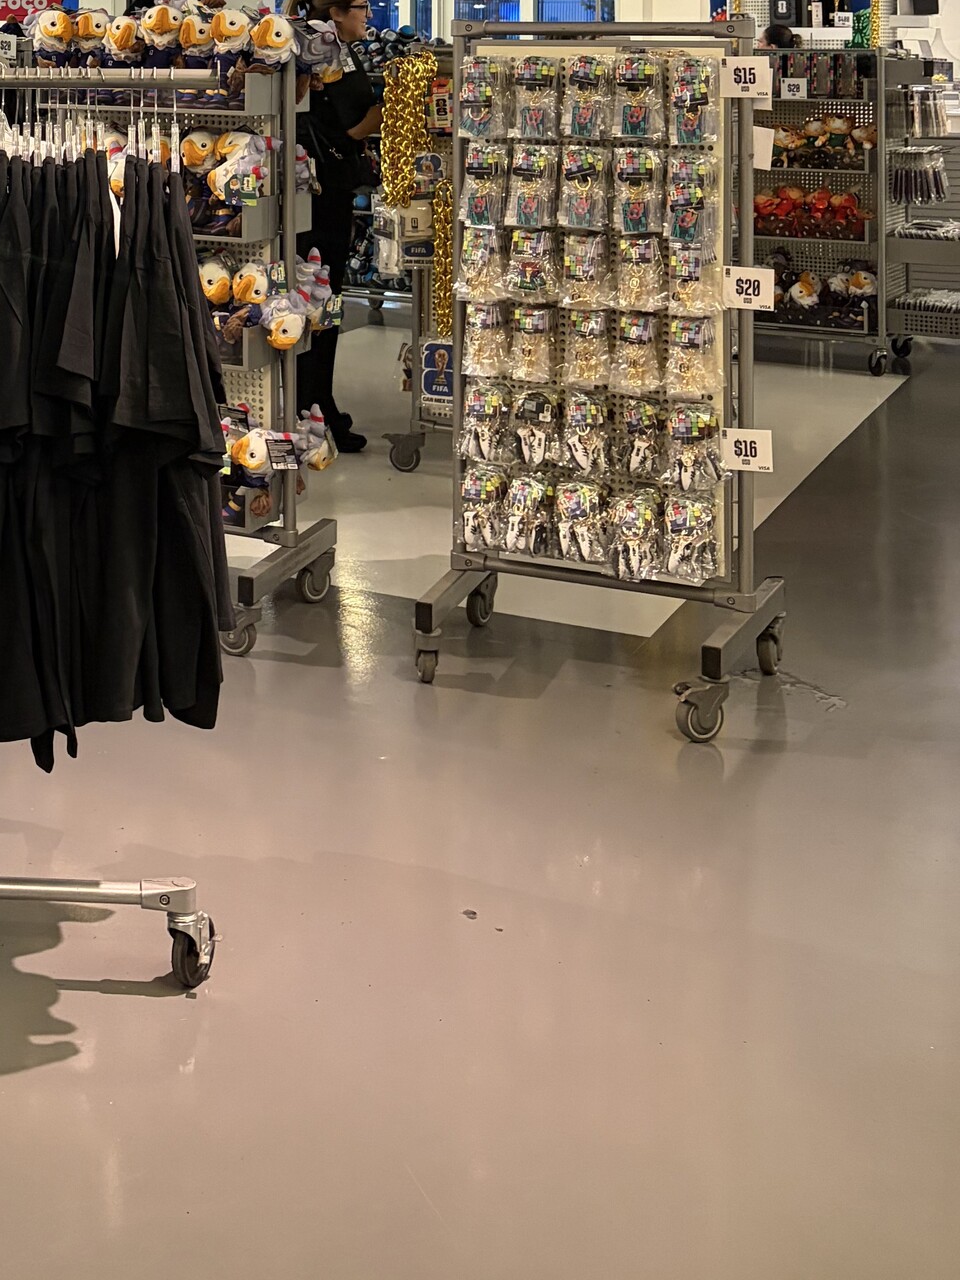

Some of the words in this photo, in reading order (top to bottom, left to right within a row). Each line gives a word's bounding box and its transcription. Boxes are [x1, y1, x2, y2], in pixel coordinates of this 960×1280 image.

[733, 66, 756, 86] $15
[410, 246, 427, 255] FIFA
[735, 277, 761, 297] $20
[432, 384, 449, 393] FIFA
[734, 438, 757, 458] $16
